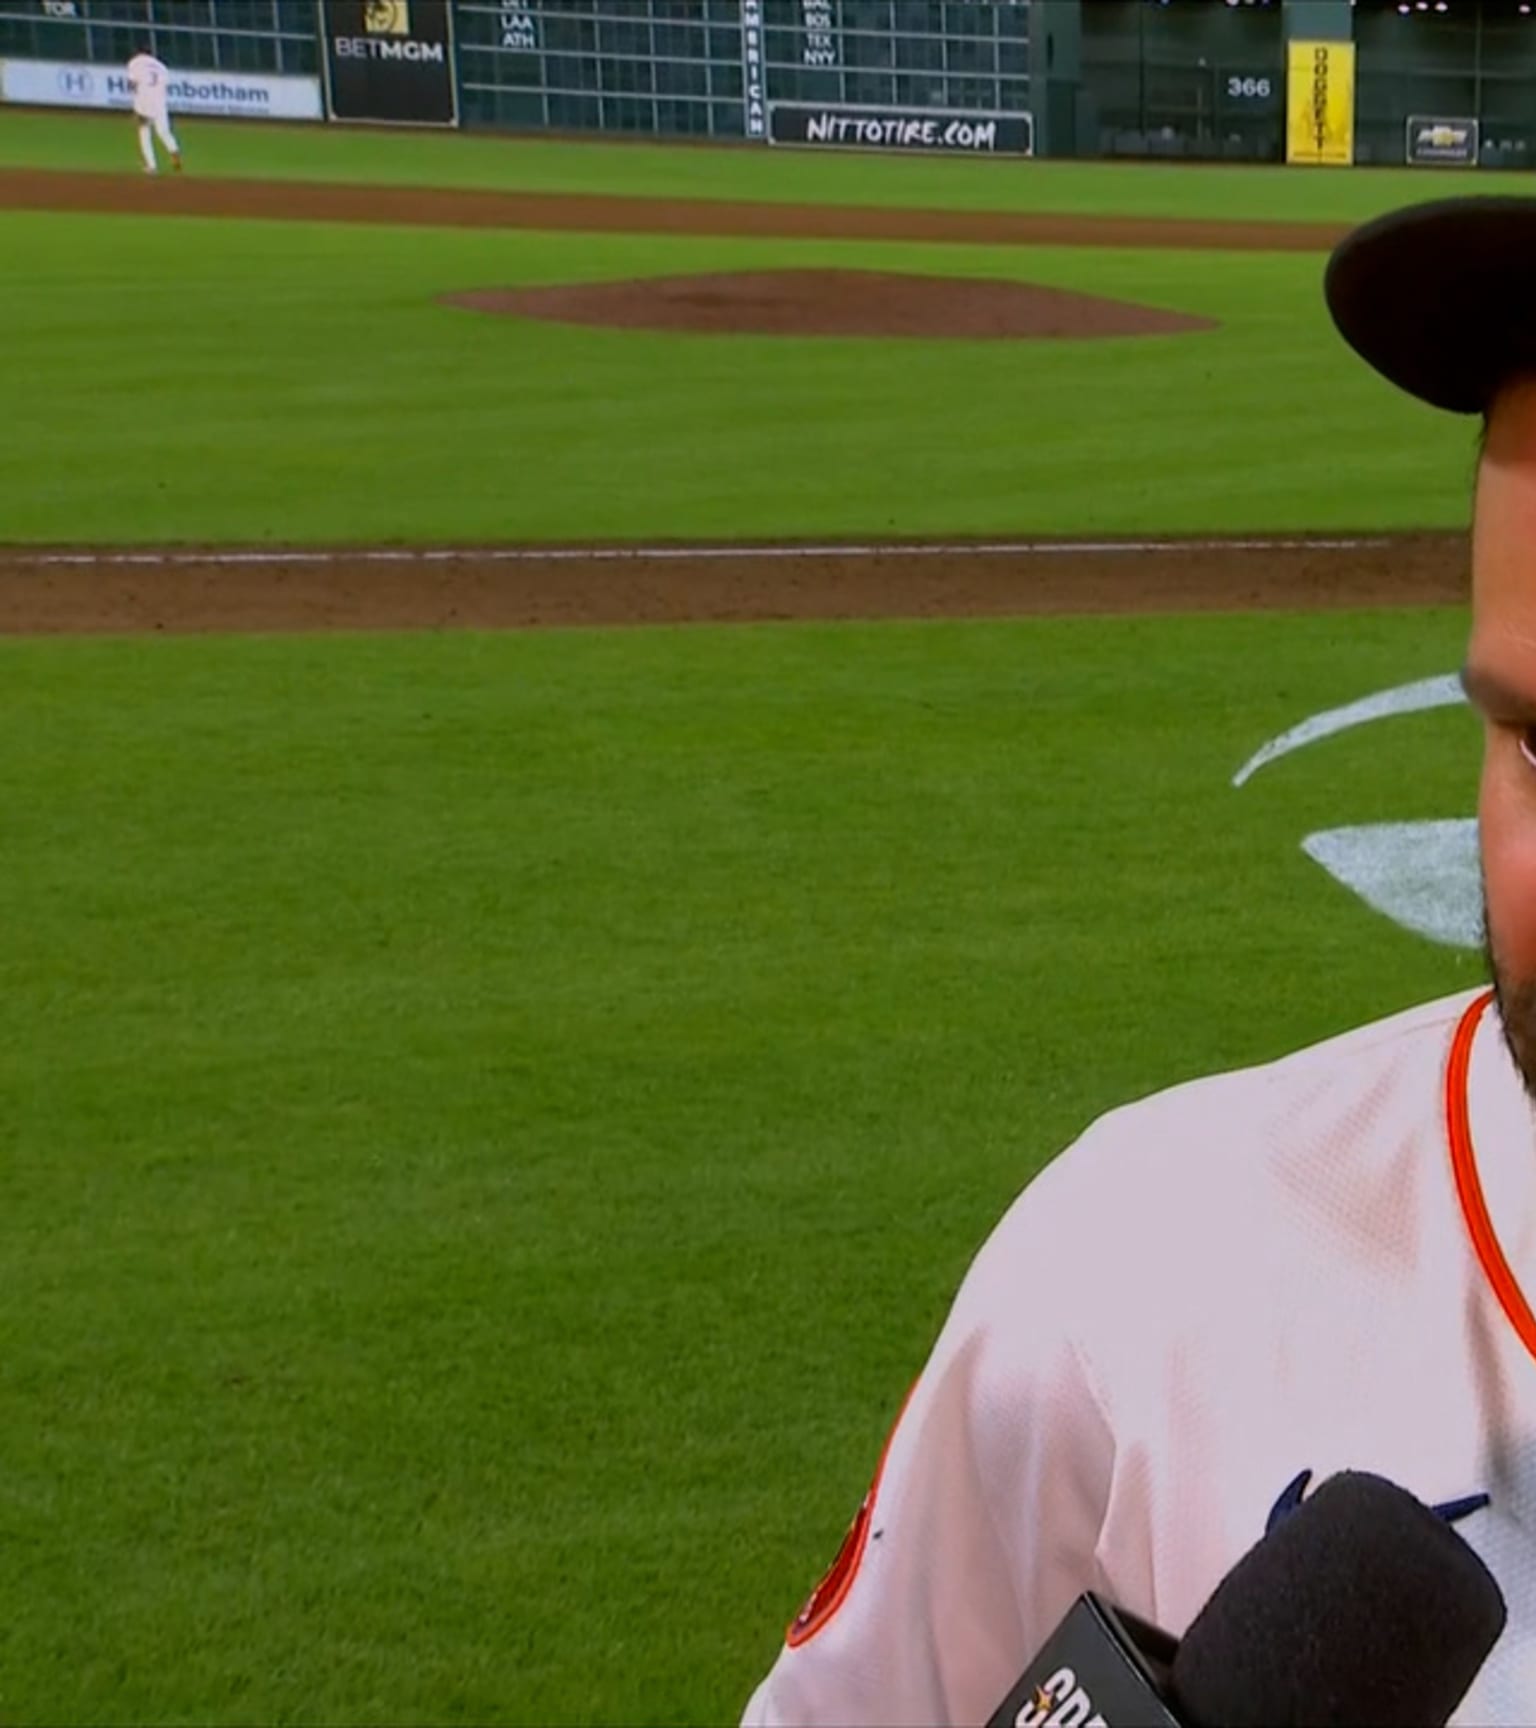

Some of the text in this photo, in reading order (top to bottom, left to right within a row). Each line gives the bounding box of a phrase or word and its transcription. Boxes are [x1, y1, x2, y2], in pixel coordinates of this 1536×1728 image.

[501, 13, 534, 30] LAA
[503, 32, 534, 48] ATH
[807, 32, 832, 47] TEX
[335, 36, 445, 62] BETMGM
[803, 48, 836, 64] NYY
[1227, 77, 1271, 97] 366
[807, 111, 997, 150] NITTOTIRE.COM
